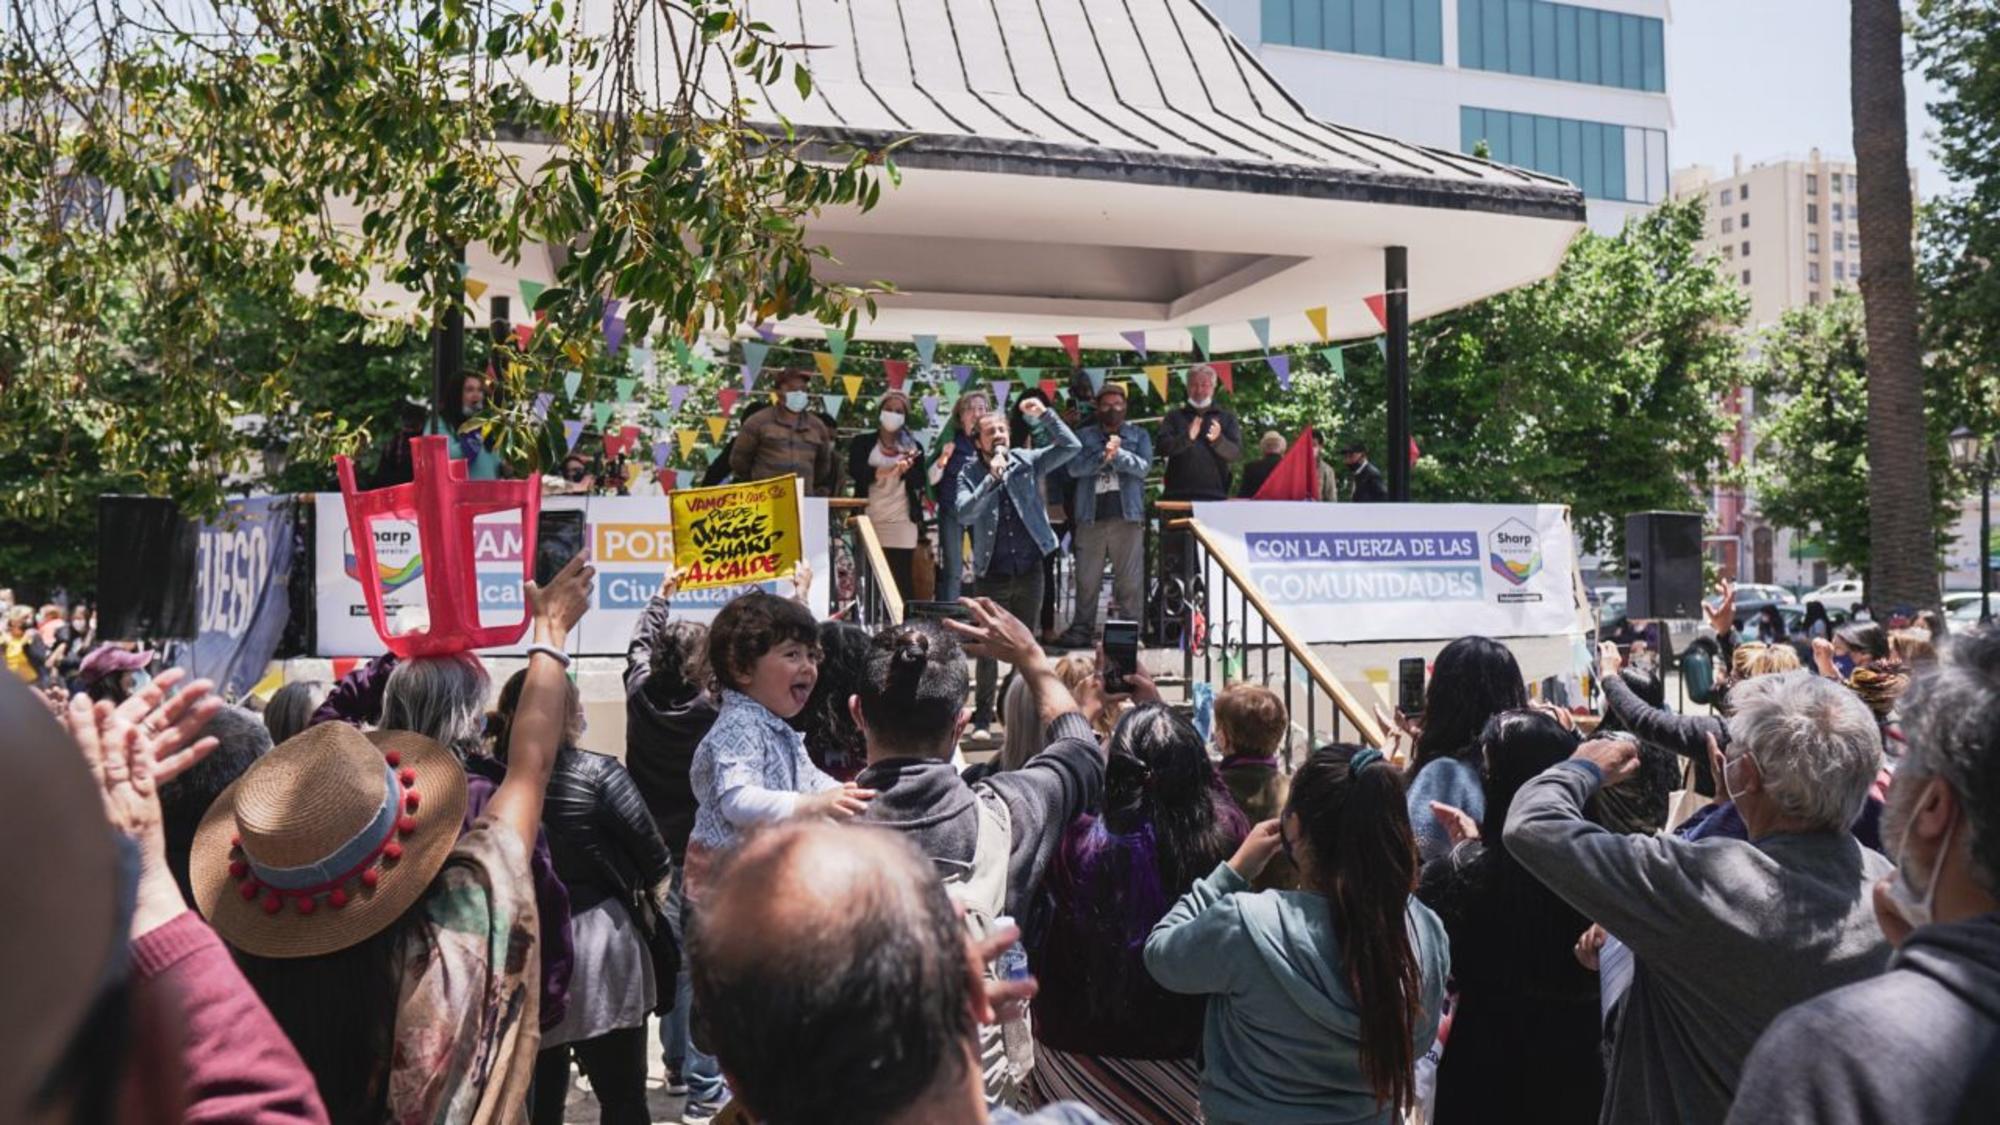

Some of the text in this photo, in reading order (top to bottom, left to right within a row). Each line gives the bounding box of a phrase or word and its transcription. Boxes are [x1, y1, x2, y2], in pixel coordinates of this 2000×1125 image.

[1254, 538, 1473, 558] CON LA FUERZA DE LAS
[1497, 532, 1532, 546] Sharp
[1260, 571, 1477, 601] COMUNIDADES
